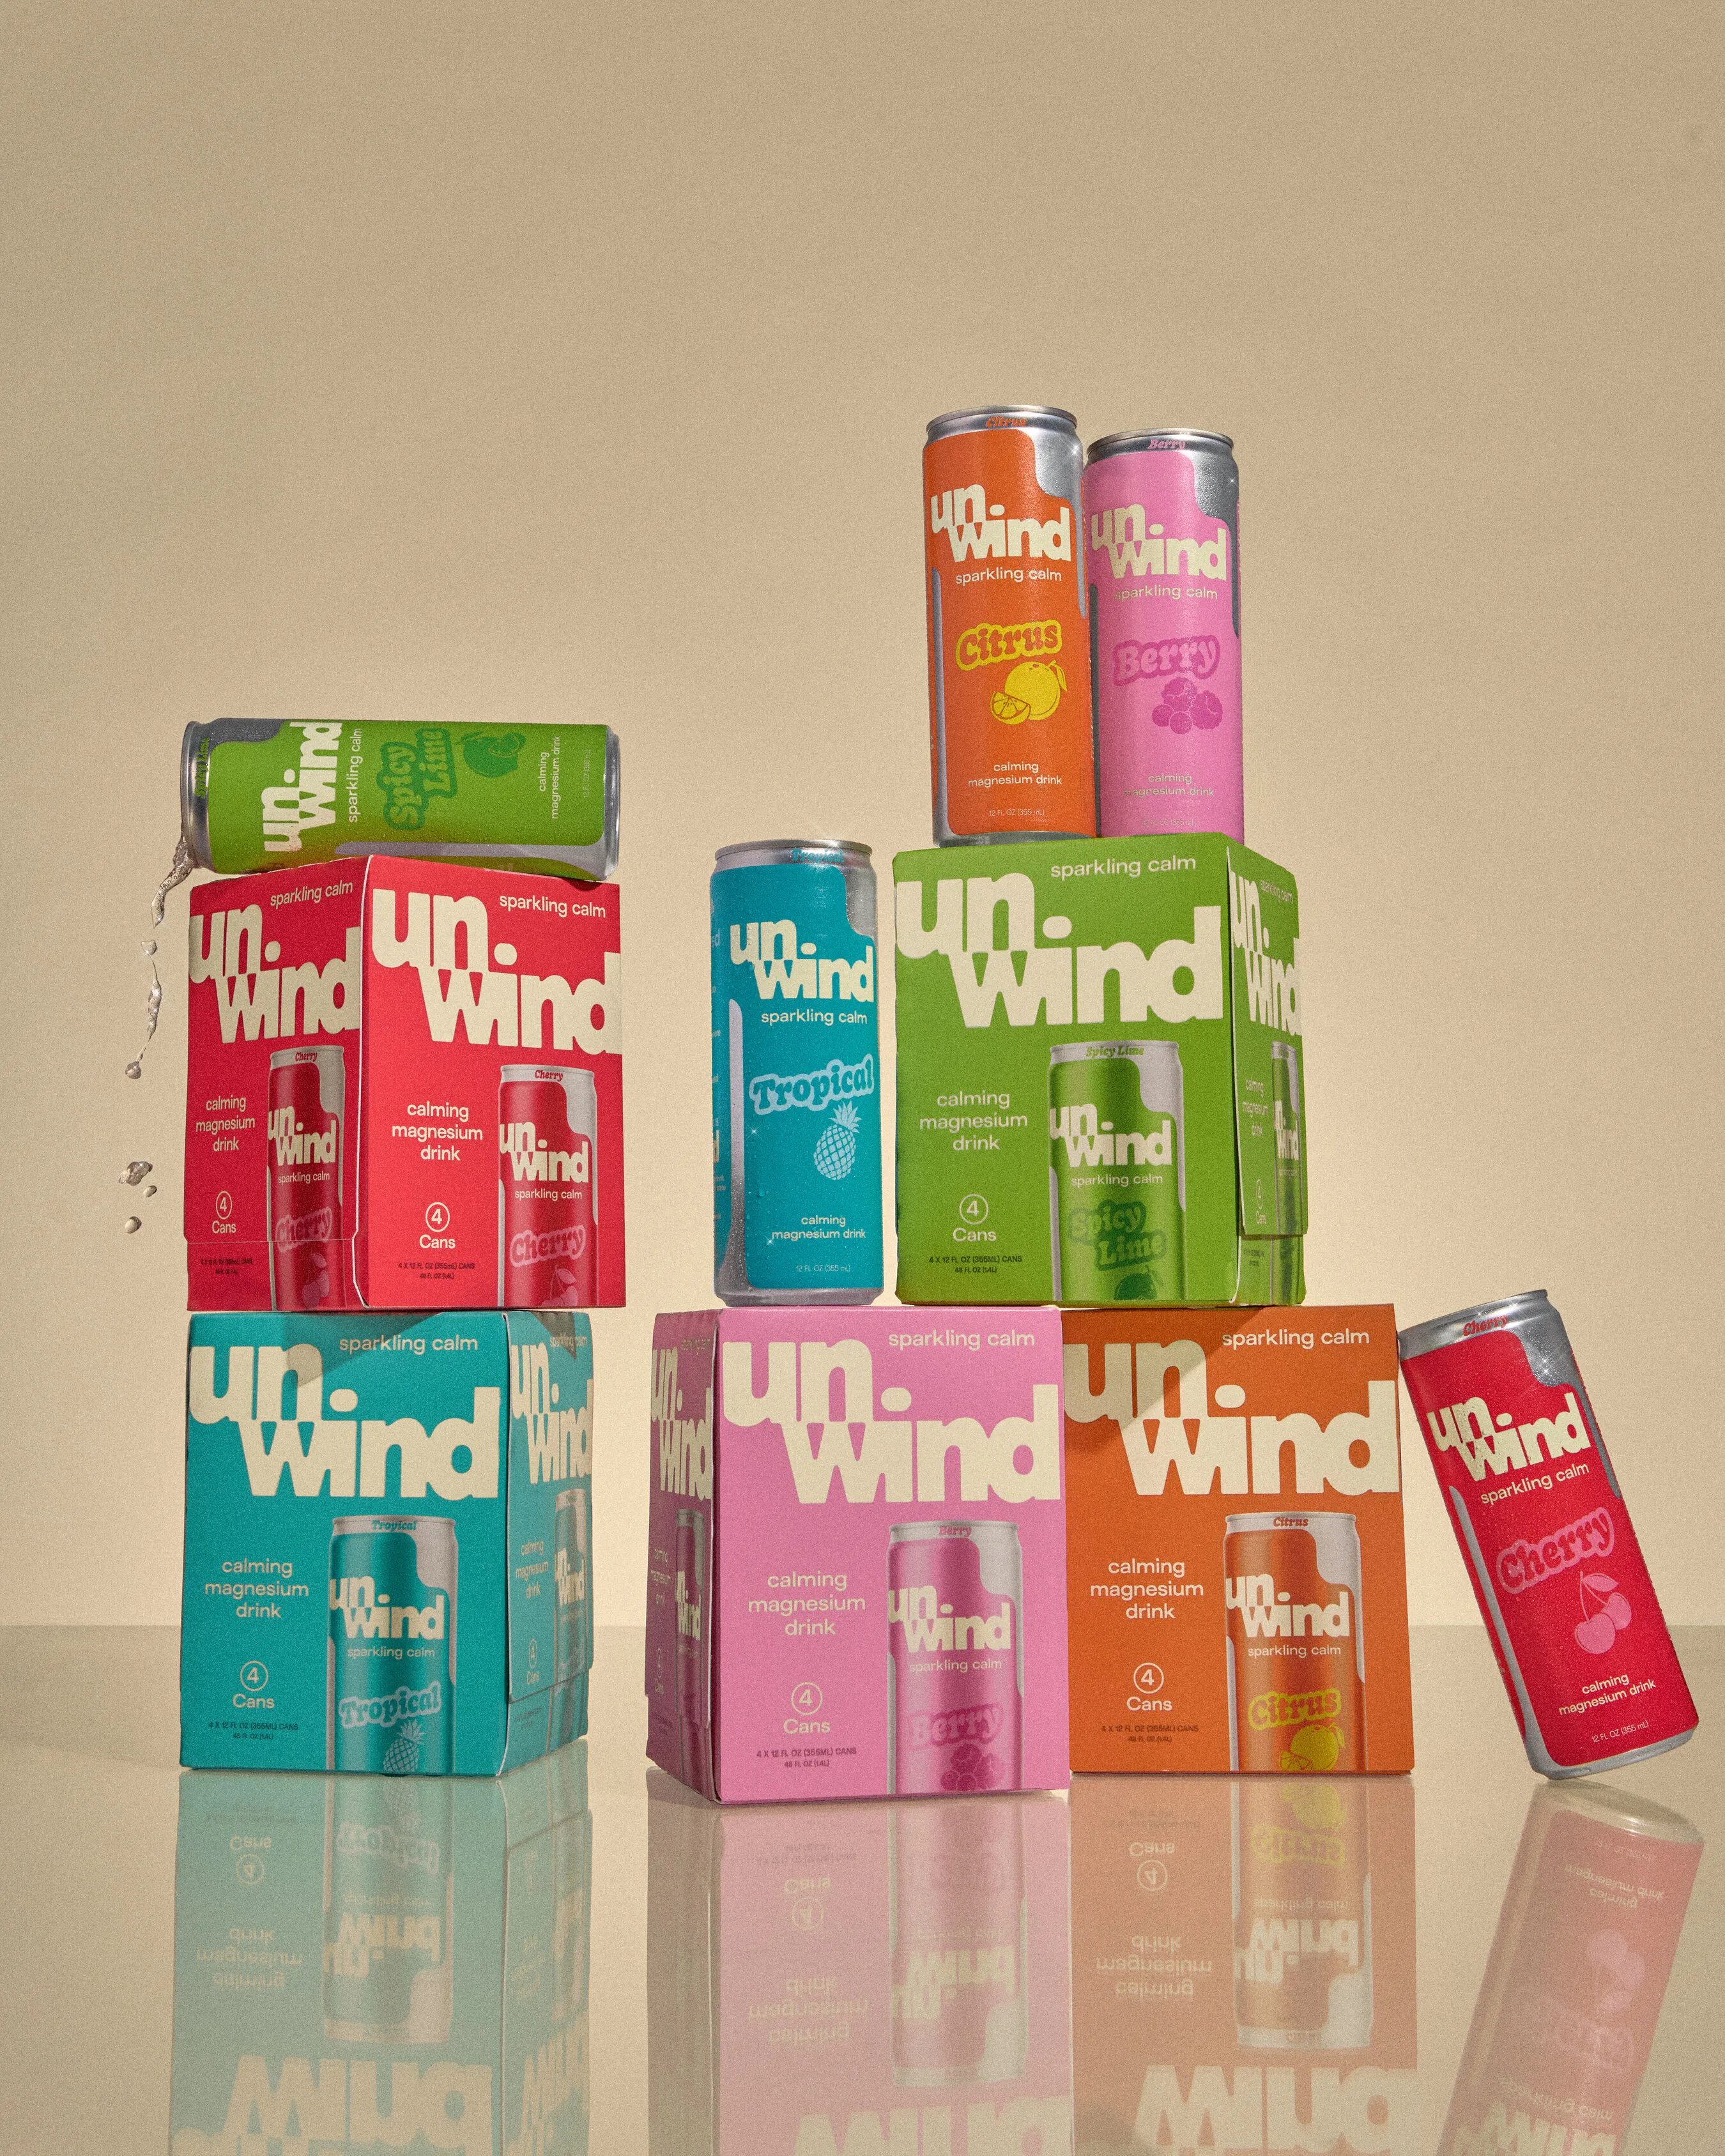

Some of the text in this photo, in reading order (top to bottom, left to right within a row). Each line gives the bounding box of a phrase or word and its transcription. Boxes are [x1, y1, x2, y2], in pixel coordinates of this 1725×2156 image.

[986, 417, 1027, 428] Citrus
[1148, 440, 1186, 450] Berry
[949, 502, 1071, 562] wind
[1108, 524, 1227, 580] wind
[955, 568, 1062, 585] sparkling calm
[1114, 586, 1218, 602] sparkling calm
[959, 623, 1059, 667] Citrus
[1116, 639, 1216, 680] Berry
[422, 730, 451, 796] Lime
[539, 752, 549, 791] calming
[993, 761, 1039, 774] calming
[289, 721, 342, 830] wind
[348, 728, 363, 823] sparkling calm
[551, 736, 560, 819] magnesium drink
[968, 773, 1062, 788] magnesium drink
[1148, 773, 1192, 786] calming
[388, 746, 417, 825] Spicy
[1123, 785, 1214, 799] magnesium drink
[792, 850, 844, 862] Tropical
[1051, 855, 1197, 880] sparkling calm
[270, 881, 353, 907] sparkling calm
[499, 894, 606, 918] sparkling calm
[754, 946, 874, 1002] wind
[949, 906, 1223, 1028] wind
[216, 926, 361, 1044] wind
[417, 952, 622, 1055] wind
[761, 1011, 868, 1025] sparkling calm
[295, 1050, 318, 1062] Cherry
[1085, 1046, 1145, 1058] Spicy Lime
[534, 1069, 563, 1082] Cherry
[755, 1059, 872, 1110] Tropical
[206, 1095, 246, 1112] calming
[937, 1091, 1011, 1110] calming
[407, 1101, 469, 1120] calming
[195, 1115, 255, 1133] magnesium
[919, 1113, 1028, 1131] magnesium
[392, 1124, 483, 1141] magnesium
[213, 1135, 240, 1152] drink
[276, 1120, 335, 1166] wind
[953, 1135, 1000, 1152] drink
[1066, 1120, 1172, 1168] wind
[420, 1145, 461, 1161] drink
[511, 1140, 588, 1183] wind
[278, 1170, 330, 1184] sparkling calm
[1071, 1174, 1163, 1188] sparkling calm
[514, 1188, 582, 1201] sparkling calm
[220, 1197, 227, 1212] 4
[966, 1201, 979, 1217] 4
[431, 1209, 442, 1225] 4
[801, 1215, 846, 1227] calming
[1072, 1204, 1142, 1236] Spicy
[211, 1220, 236, 1234] Cans
[277, 1210, 330, 1248] Cherry
[771, 1228, 866, 1241] magnesium drink
[953, 1227, 997, 1243] Cans
[419, 1234, 456, 1249] Cans
[512, 1230, 582, 1263] Cherry
[1100, 1236, 1162, 1265] Lime
[1002, 1255, 1022, 1263] CANS
[1463, 1313, 1508, 1336] Cherry
[339, 1336, 479, 1354] sparkling calm
[889, 1330, 1035, 1350] sparkling calm
[1222, 1330, 1369, 1350] sparkling calm
[239, 1387, 500, 1500] wind
[781, 1384, 1061, 1504] wind
[1118, 1380, 1399, 1496] wind
[1456, 1393, 1591, 1481] wind
[1481, 1462, 1590, 1504] sparkling calm
[371, 1520, 417, 1532] Tropical
[939, 1525, 972, 1538] Berry
[1273, 1517, 1309, 1528] Citrus
[1500, 1509, 1610, 1591] Cherry
[222, 1559, 293, 1579] calming
[1108, 1559, 1185, 1579] calming
[767, 1571, 848, 1591] calming
[1091, 1581, 1204, 1600] magnesium
[205, 1582, 309, 1600] magnesium
[236, 1602, 282, 1618] drink
[749, 1595, 865, 1614] magnesium
[1126, 1603, 1176, 1619] drink
[345, 1594, 445, 1640] wind
[1242, 1592, 1349, 1638] wind
[785, 1618, 836, 1635] drink
[904, 1603, 1011, 1653] wind
[1248, 1644, 1341, 1658] sparkling calm
[247, 1667, 259, 1683] 4
[1141, 1670, 1154, 1686] 4
[1581, 1672, 1629, 1695] calming
[233, 1693, 275, 1709] Cans
[341, 1686, 438, 1722] Tropical
[799, 1690, 813, 1707] 4
[1126, 1697, 1172, 1712] Cans
[1558, 1679, 1657, 1716] magnesium drink
[1252, 1693, 1338, 1724] Citrus
[783, 1717, 830, 1734] Cans
[910, 1708, 1000, 1743] Berry
[1591, 1735, 1598, 1743] 12
[1601, 1732, 1609, 1741] FL
[1609, 1730, 1620, 1739] OZ
